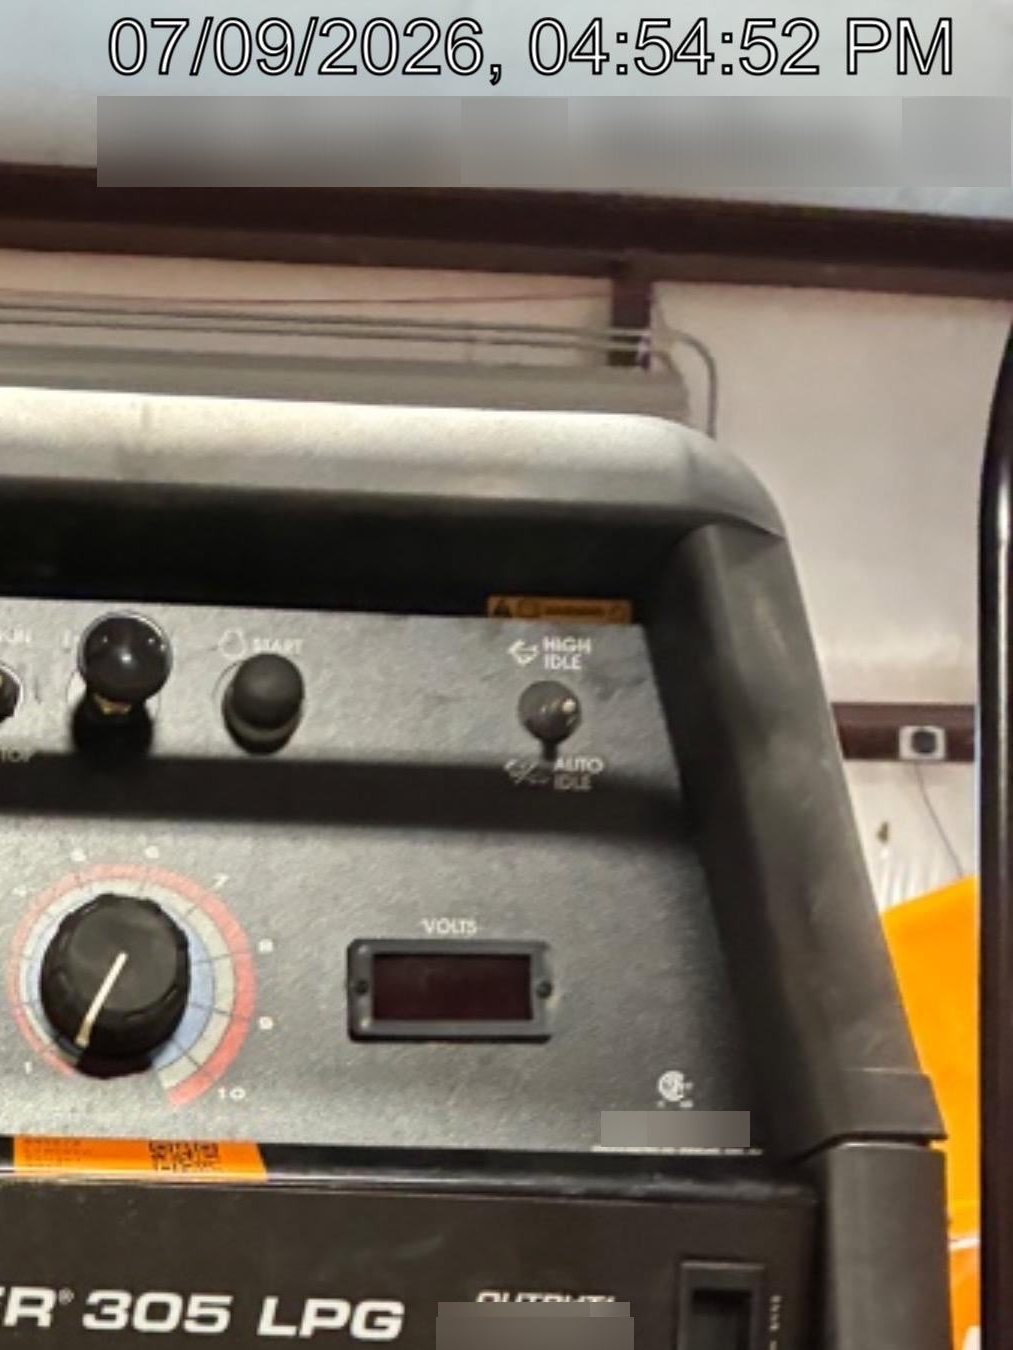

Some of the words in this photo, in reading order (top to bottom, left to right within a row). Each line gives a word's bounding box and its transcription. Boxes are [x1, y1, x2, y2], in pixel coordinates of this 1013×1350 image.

[543, 636, 591, 653] HIGH
[544, 654, 582, 670] IDLE
[554, 757, 604, 774] AUTO
[554, 775, 591, 791] IDLE
[421, 918, 478, 935] VOLTS
[217, 1087, 246, 1100] 10
[82, 1289, 233, 1334] 305
[257, 1294, 405, 1341] LPG
